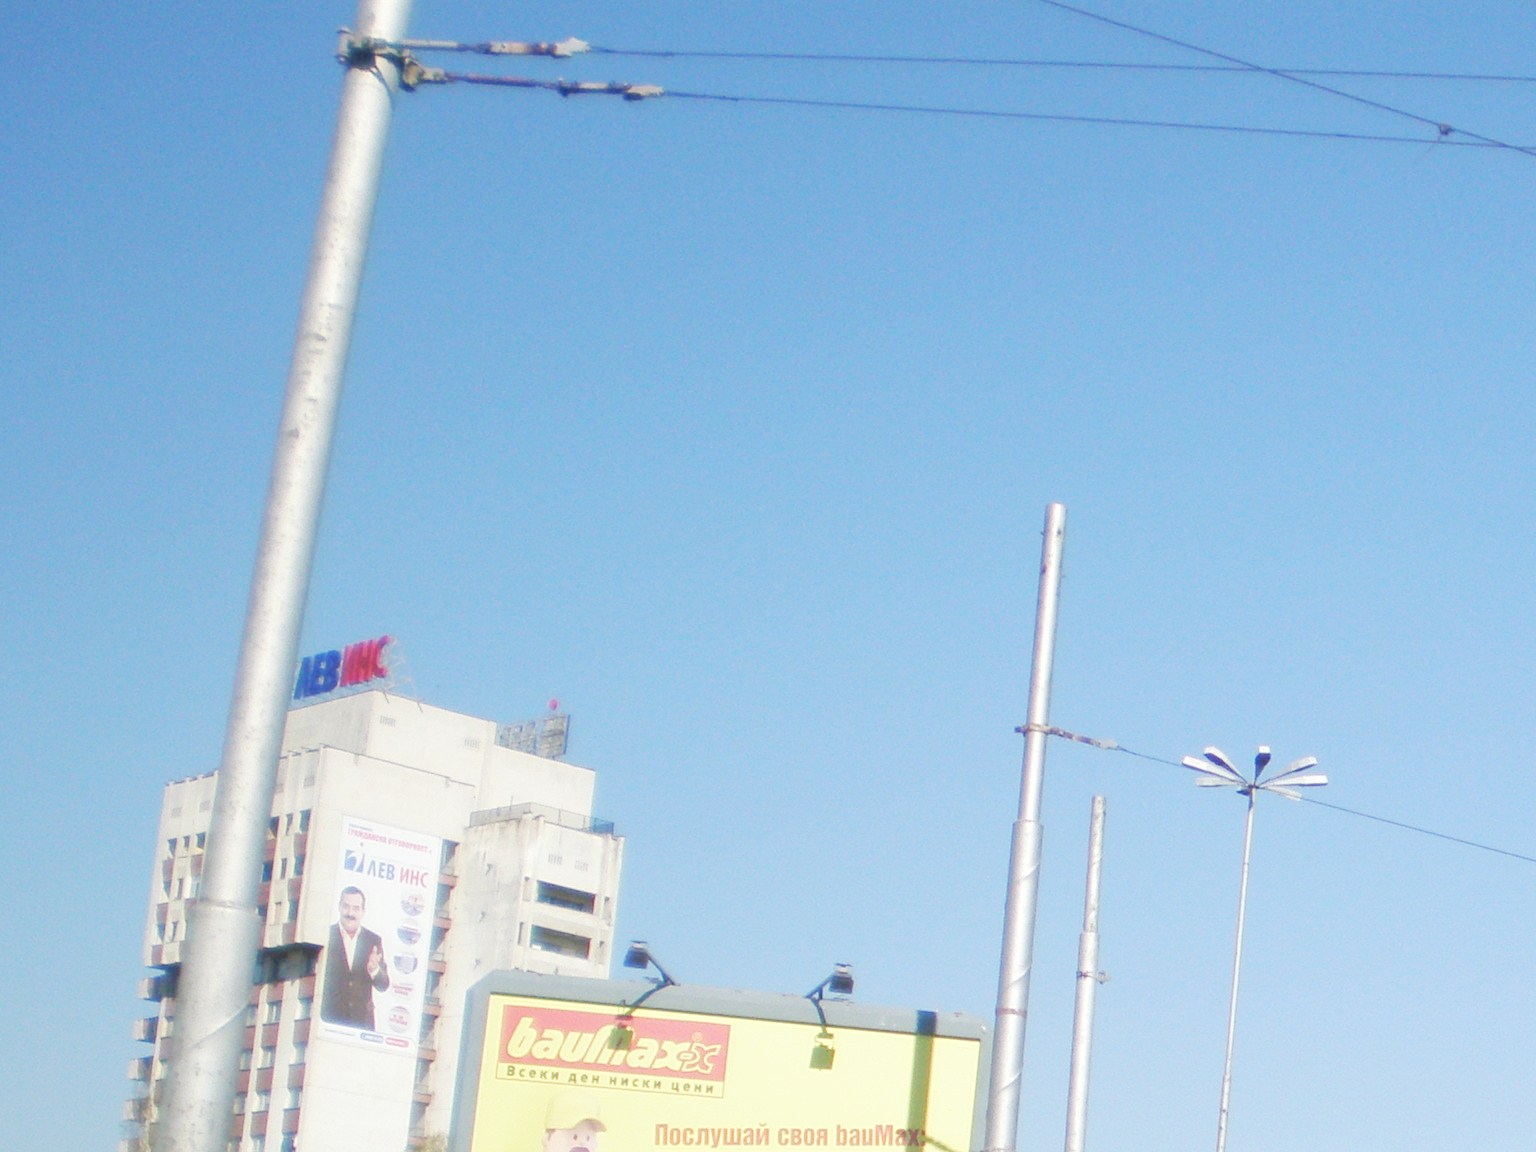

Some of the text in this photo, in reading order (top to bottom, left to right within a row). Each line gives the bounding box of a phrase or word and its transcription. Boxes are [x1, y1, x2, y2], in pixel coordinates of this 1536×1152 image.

[367, 860, 429, 888] ЛЕВ ИНС
[506, 1065, 715, 1095] Всеки ден ниски цени
[654, 1123, 926, 1148] Послушай своя bauMax:
